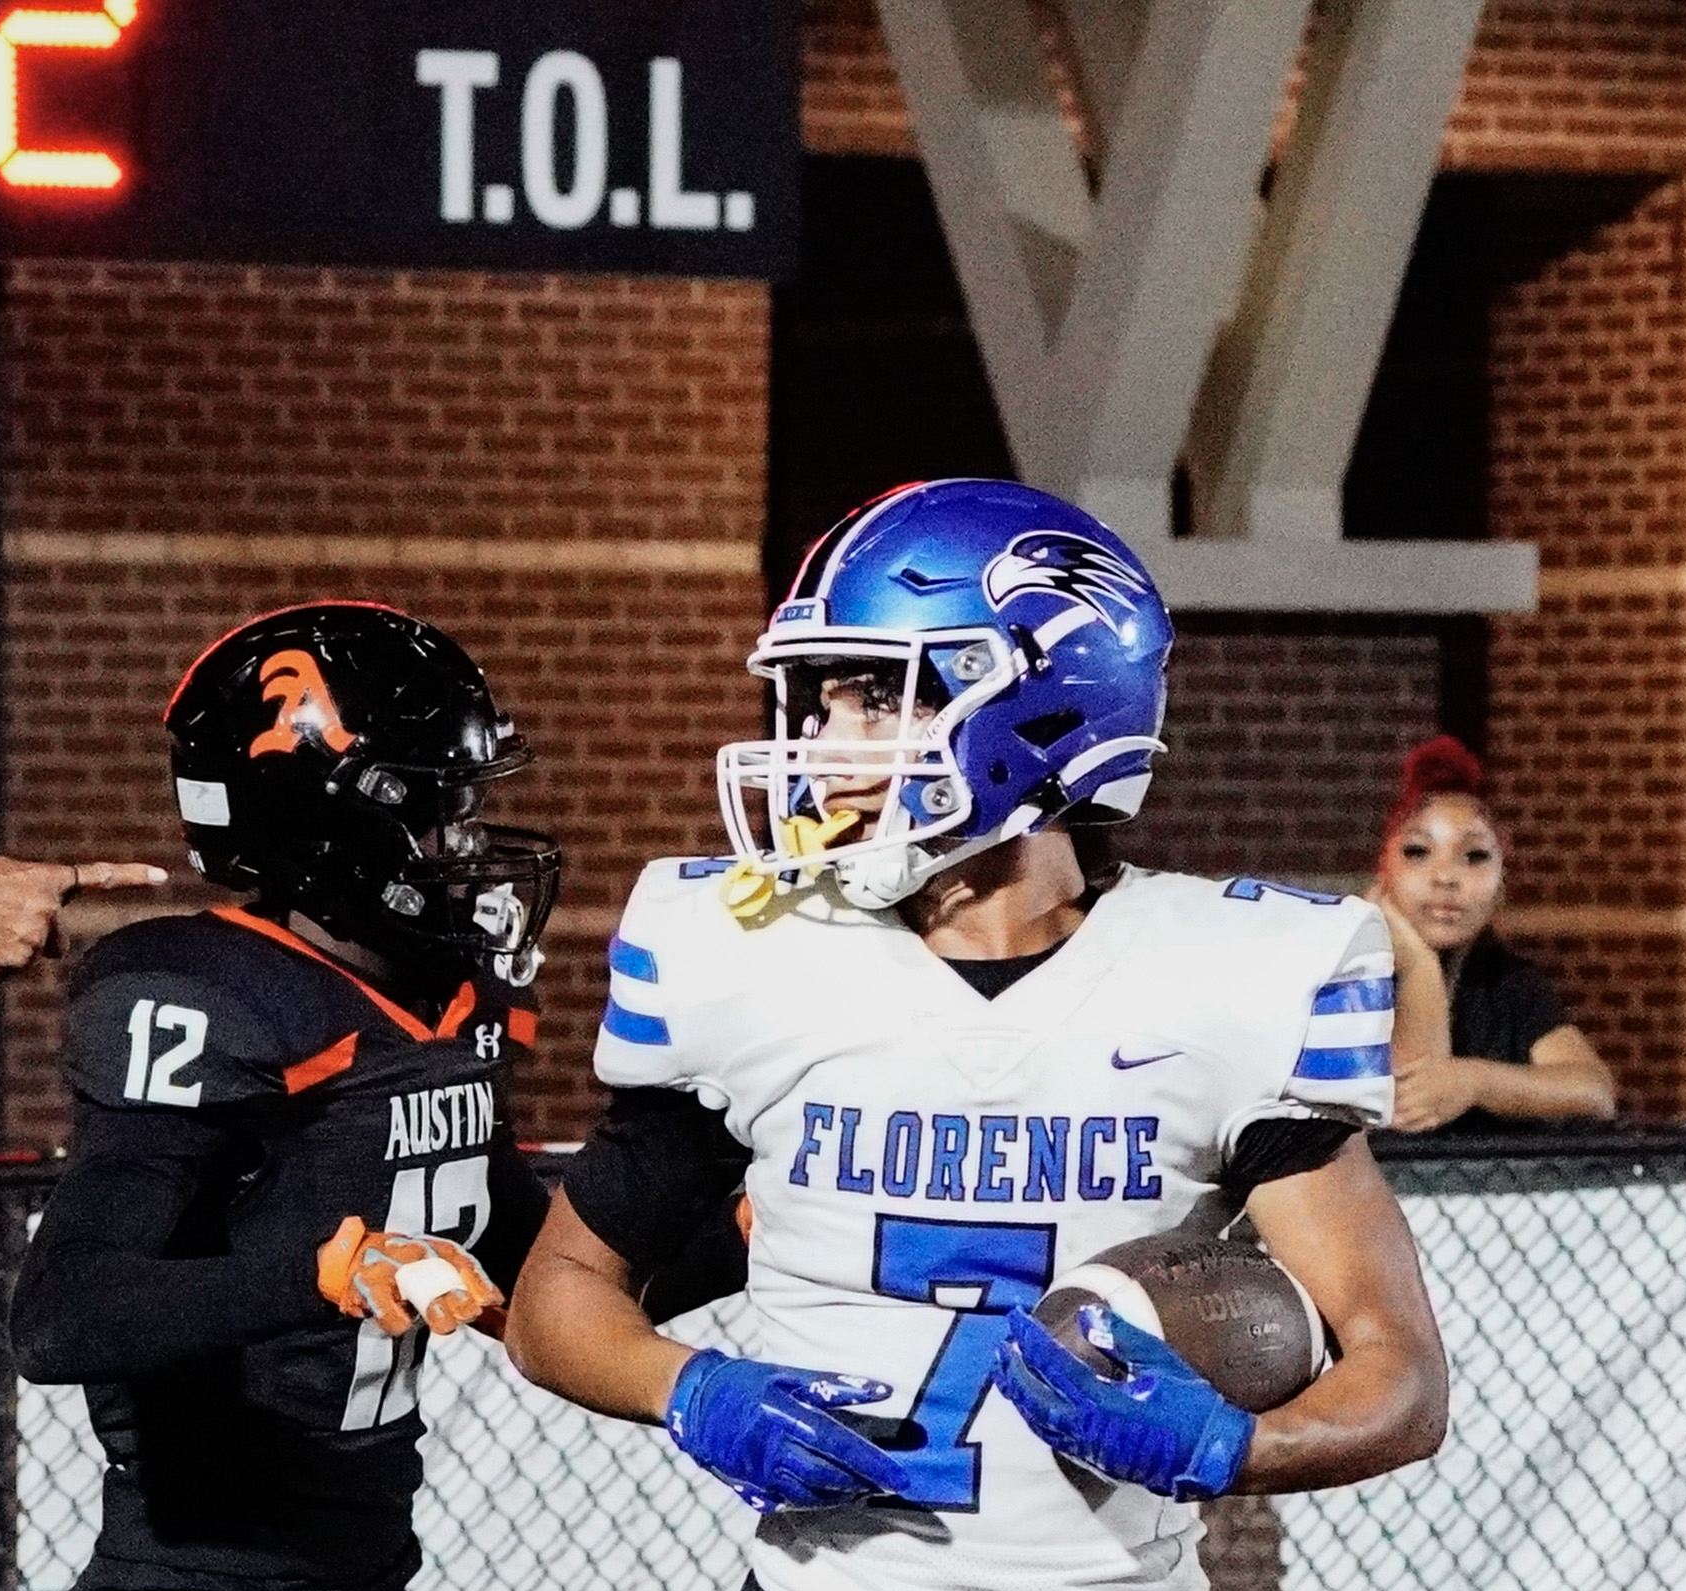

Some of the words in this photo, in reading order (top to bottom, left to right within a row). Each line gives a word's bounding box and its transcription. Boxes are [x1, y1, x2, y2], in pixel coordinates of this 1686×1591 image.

[415, 47, 755, 231] T.O.L.
[123, 999, 208, 1108] 12
[384, 1081, 495, 1161] AUSTIN
[789, 1102, 1164, 1203] FLORENCE
[871, 1213, 1058, 1514] 7
